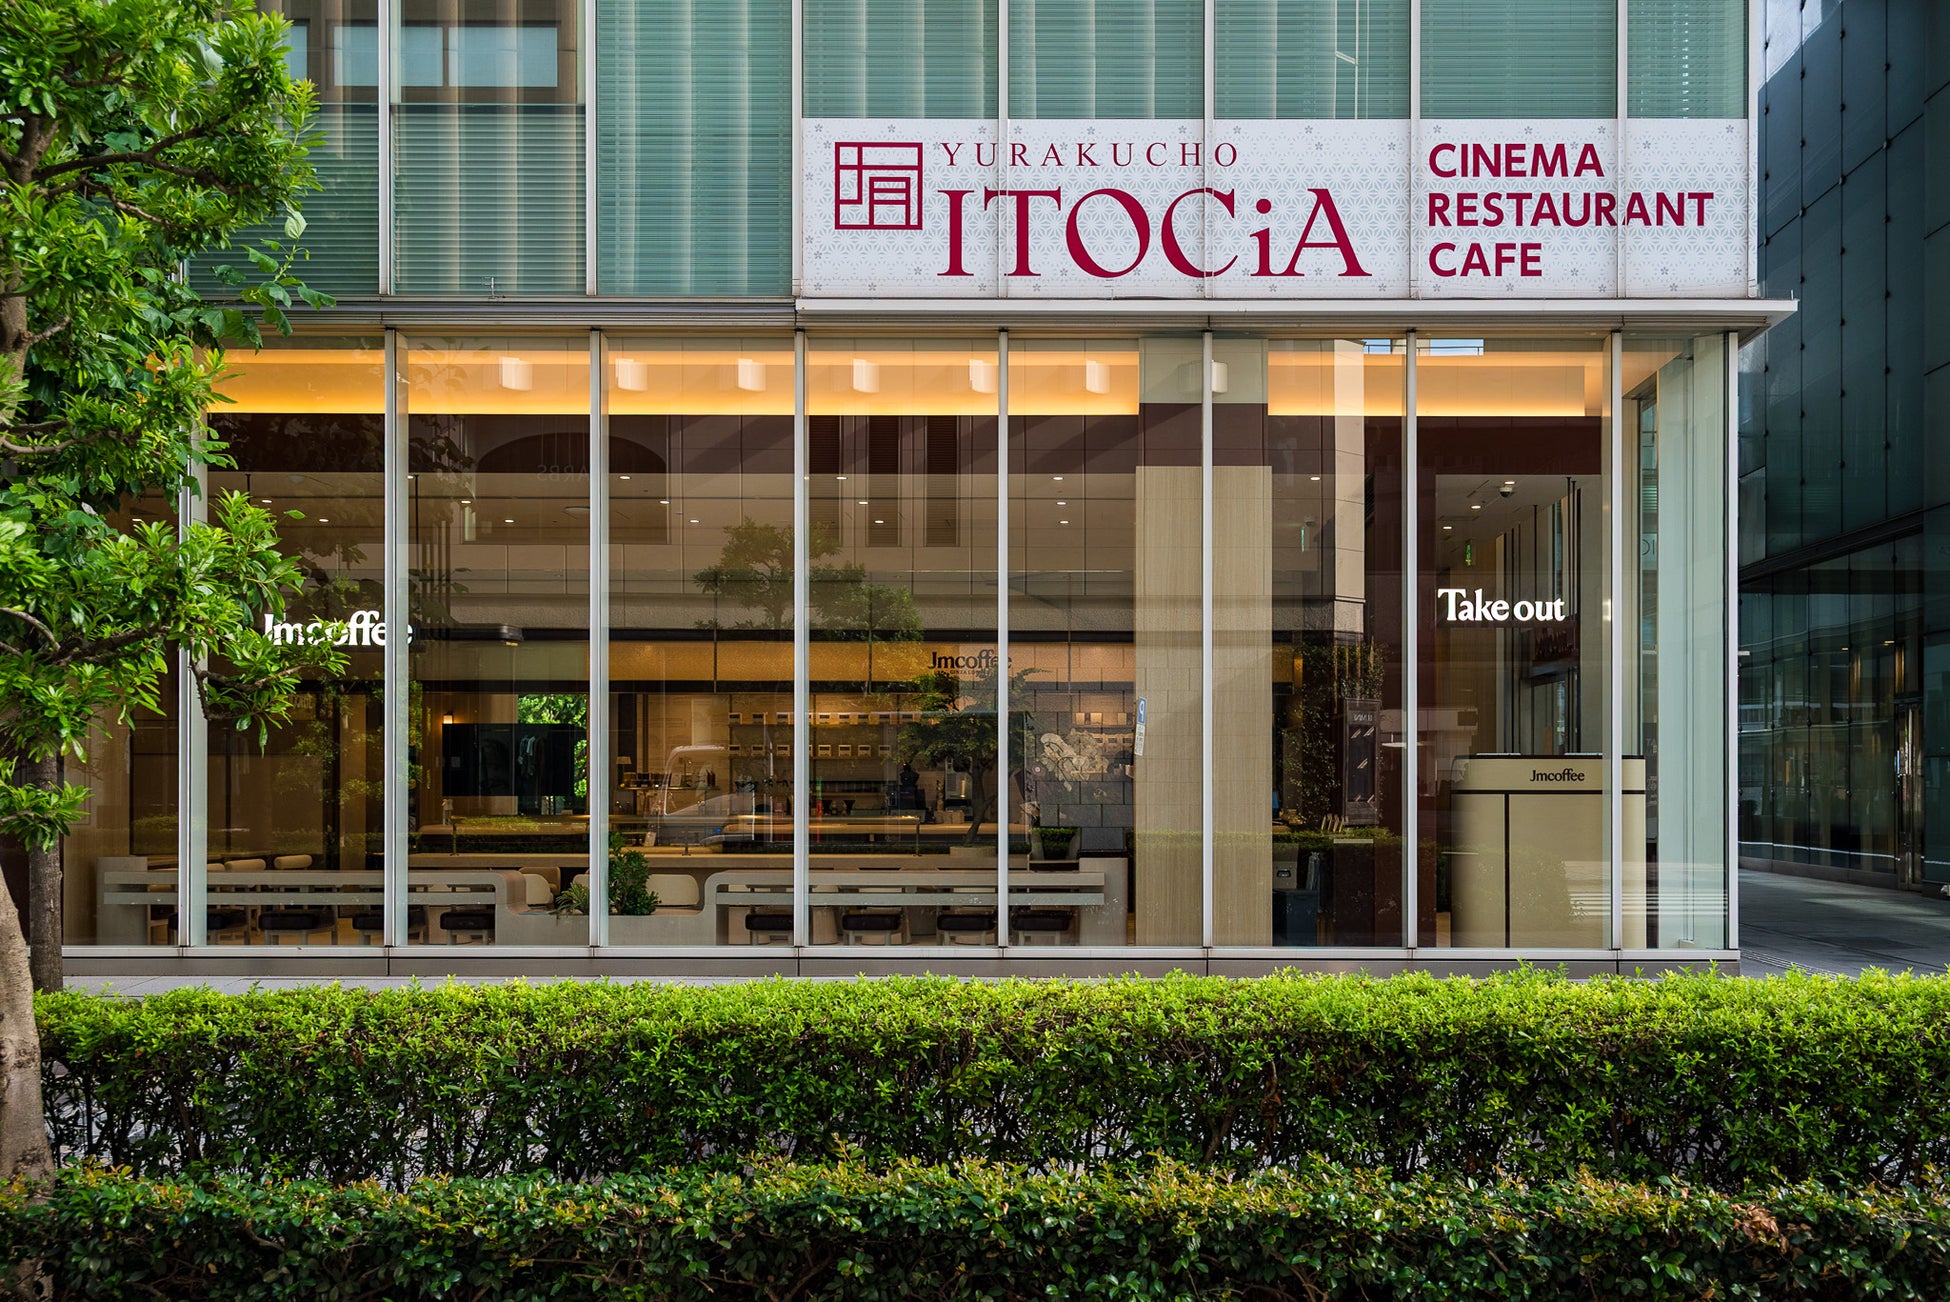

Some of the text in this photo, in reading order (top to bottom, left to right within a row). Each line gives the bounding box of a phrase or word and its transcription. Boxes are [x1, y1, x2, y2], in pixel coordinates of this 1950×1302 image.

[941, 142, 1238, 167] YURAKUCHO
[1429, 144, 1602, 178] CINEMA
[1429, 193, 1713, 226] RESTAURANT
[937, 186, 1373, 279] ITOCiA
[1429, 243, 1541, 276] CAFE
[1438, 589, 1565, 620] Take out
[1530, 768, 1585, 782] Jmcoffee
